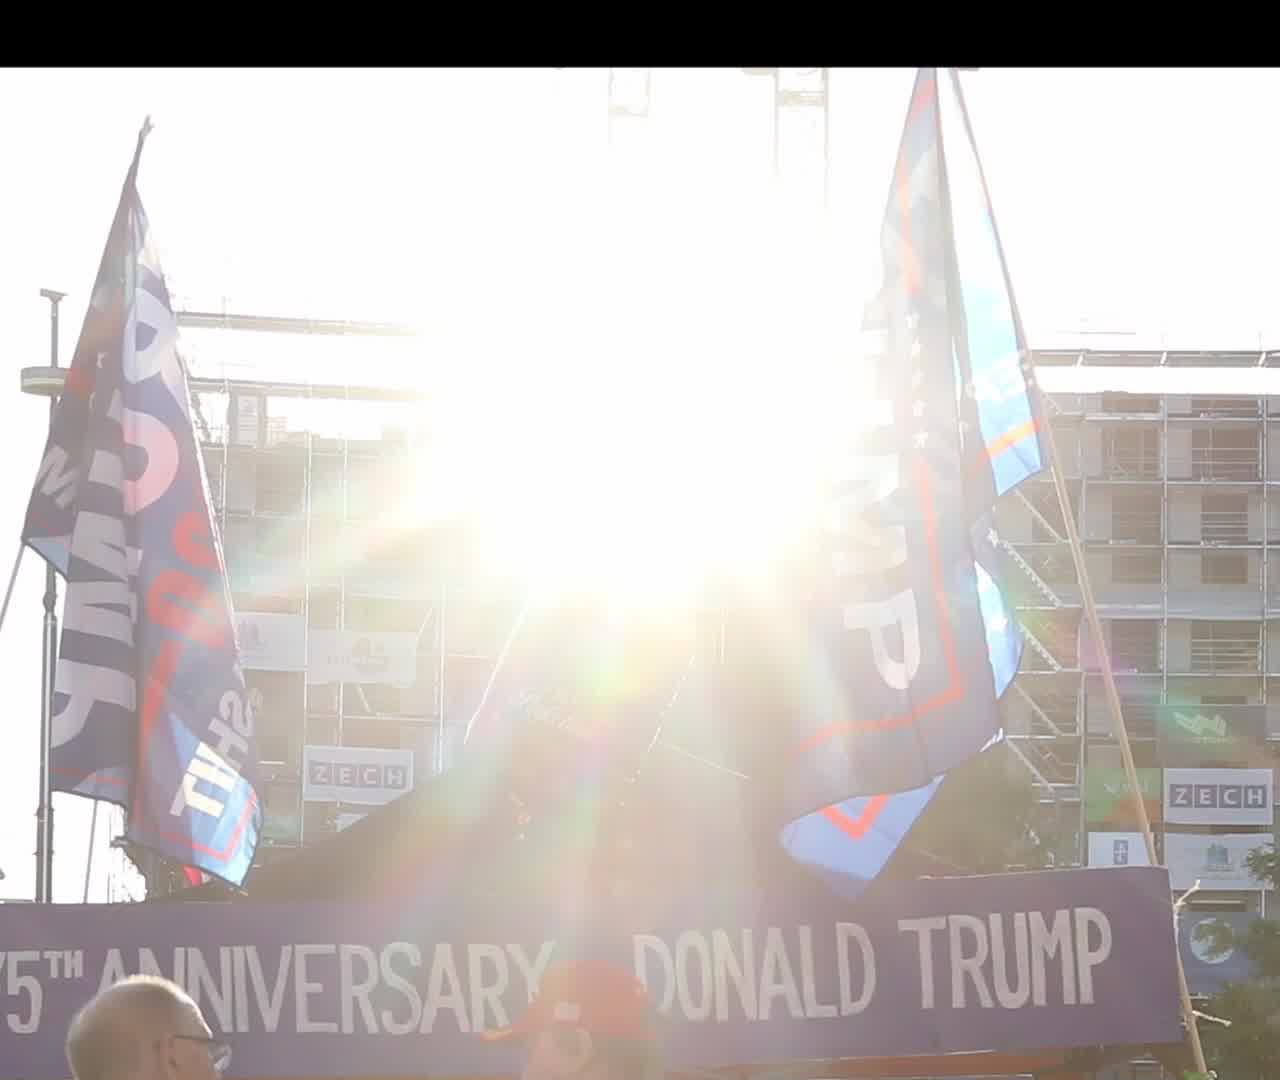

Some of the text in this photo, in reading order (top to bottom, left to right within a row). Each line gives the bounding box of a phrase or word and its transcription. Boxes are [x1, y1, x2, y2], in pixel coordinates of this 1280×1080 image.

[311, 764, 405, 787] ZECH
[1173, 786, 1265, 806] ZECH
[632, 907, 1113, 1023] DONALD TRUMP
